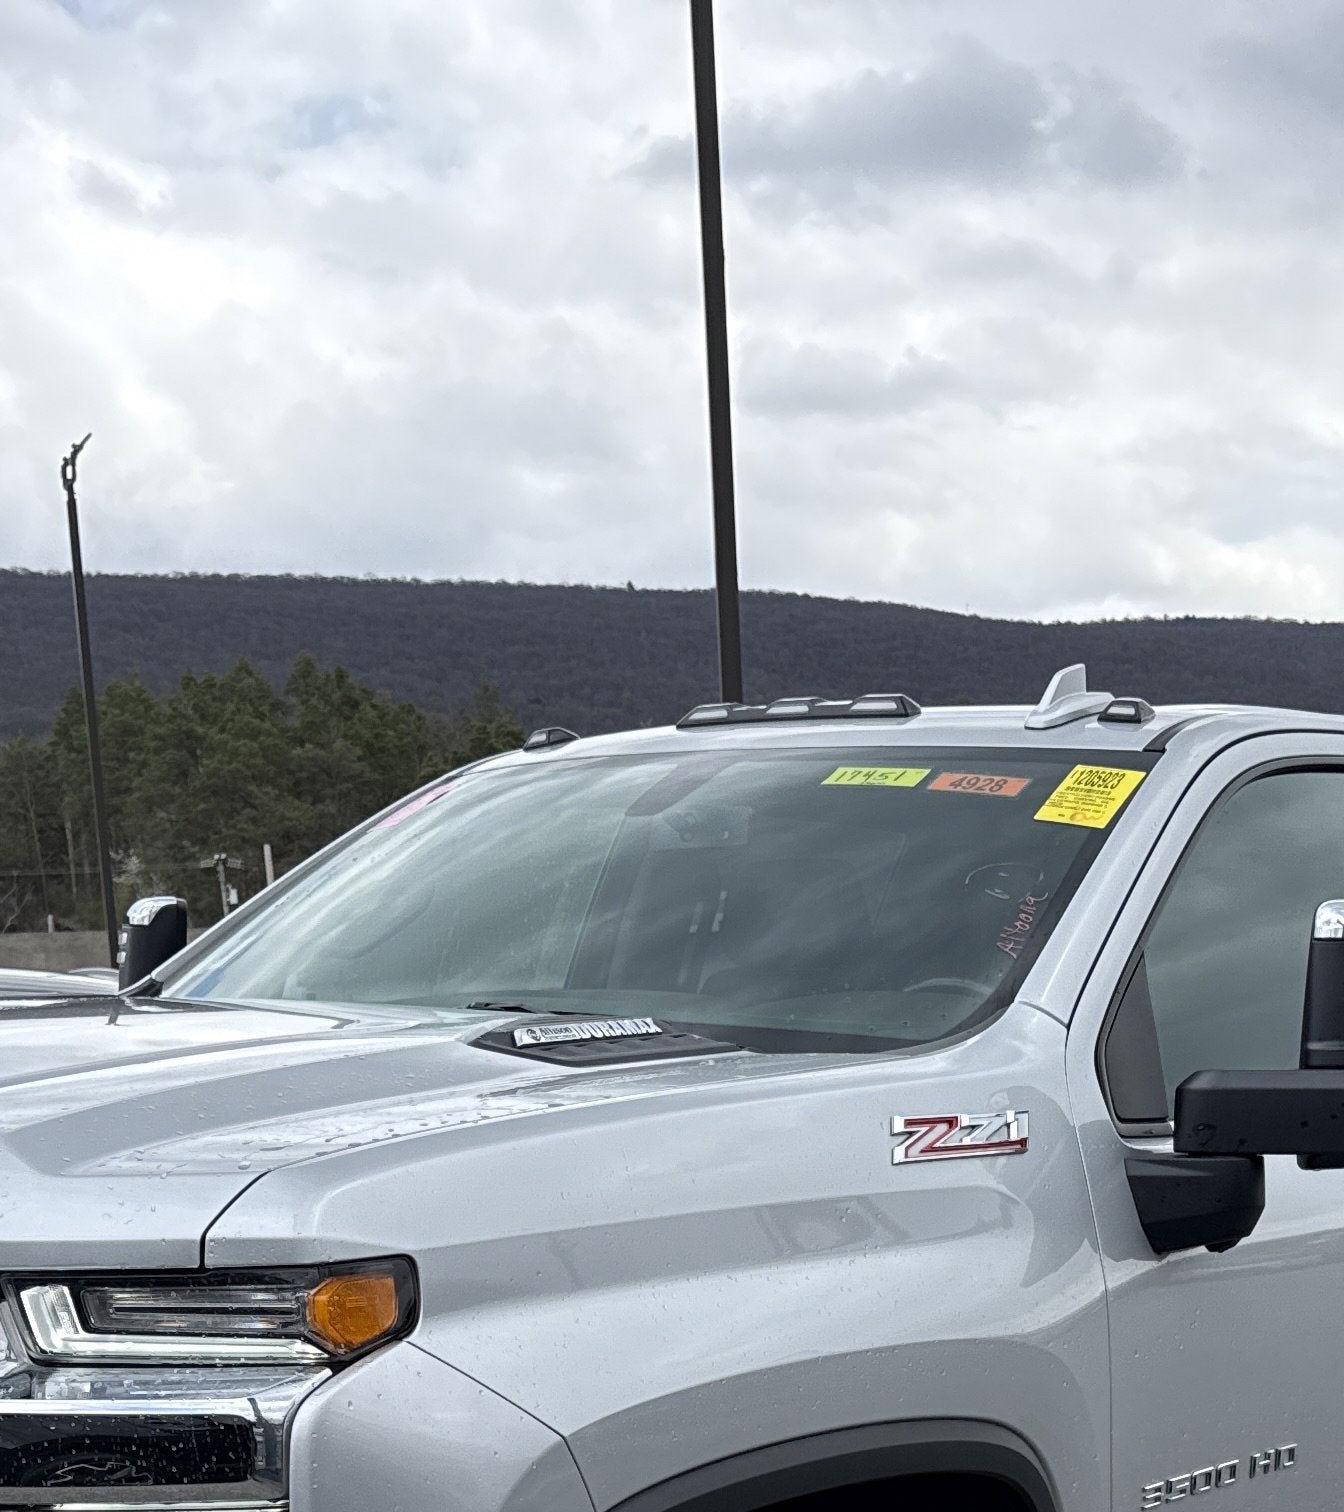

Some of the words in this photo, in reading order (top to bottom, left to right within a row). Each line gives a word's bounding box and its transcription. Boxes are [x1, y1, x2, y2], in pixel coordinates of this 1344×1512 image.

[949, 776, 1008, 792] 4928
[574, 1017, 663, 1039] DURAMAX
[890, 1109, 1030, 1166] Z71
[1140, 1458, 1240, 1512] 3500
[1248, 1443, 1298, 1480] HD
